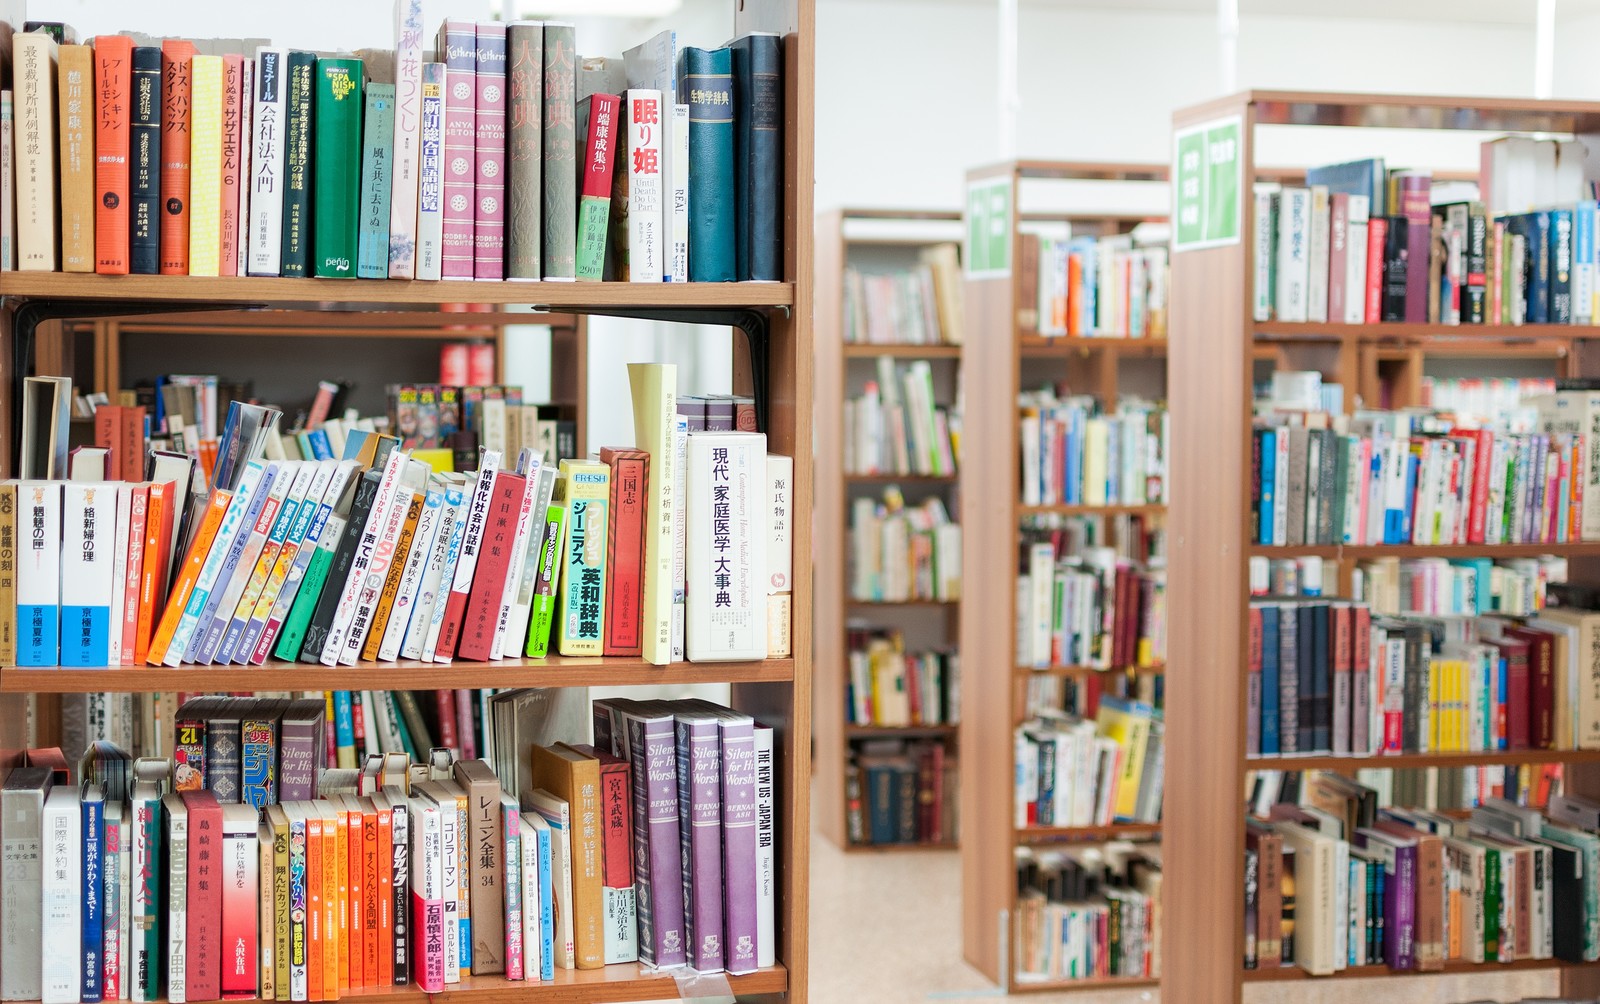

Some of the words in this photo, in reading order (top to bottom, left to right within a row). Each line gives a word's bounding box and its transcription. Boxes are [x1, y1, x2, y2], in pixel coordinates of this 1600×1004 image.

[101, 59, 110, 130] レールモントフ
[166, 62, 176, 132] スタインベック
[177, 62, 187, 132] ドス・パソス
[225, 65, 237, 105] よりぬき
[262, 53, 275, 101] ゼミナール
[333, 82, 356, 90] NISH
[691, 89, 730, 105] 生物学辞典
[24, 46, 40, 155] 最高裁判所判例解説
[68, 70, 84, 133] 徳川家康
[224, 110, 238, 169] サザエさん
[257, 105, 277, 193] 会社法入門
[633, 99, 659, 174] 眠り姫
[224, 175, 233, 185] 6
[370, 147, 385, 227] 風と共に去りぬ
[636, 179, 655, 187] Until
[638, 203, 653, 211] Part
[675, 189, 685, 215] REAL
[677, 436, 686, 458] RSPB
[712, 447, 730, 481] 現代
[369, 455, 400, 533] 人生がうまくいかない人は
[574, 473, 607, 483] FRESH
[738, 472, 748, 516] Contemporary
[463, 468, 495, 557] 情報化社会対話集
[490, 489, 513, 557] 夏目漱石集
[661, 485, 672, 535] 分析資料
[713, 485, 731, 551] 家庭医学
[774, 480, 786, 531] 源氏物語
[1, 525, 13, 570] 修羅の刻
[32, 506, 45, 550] 魍魎の匣
[82, 507, 95, 562] 絡新婦の理
[349, 516, 362, 538] 天使
[431, 507, 458, 572] 今夜は眠れない
[571, 501, 587, 566] ジーニアス
[587, 506, 601, 562] フレッシュ
[675, 509, 684, 583] BIRDWATCHING
[739, 519, 748, 537] Home
[127, 521, 144, 580] ピーチガール
[354, 532, 376, 570] 声で損
[384, 529, 412, 591] あした天気になあれ
[739, 540, 748, 565] Medical
[578, 567, 601, 636] 英和辞典
[622, 582, 630, 621] 吉川英治全集
[714, 556, 732, 608] 大事典
[739, 567, 749, 608] Encyclopedia
[32, 607, 44, 647] 京極夏彦
[81, 607, 93, 647] 京極夏彦
[347, 605, 370, 650] 猿渡哲也
[497, 604, 511, 633] 深見東州
[180, 727, 198, 743] 12
[251, 732, 270, 743] 少年
[650, 759, 663, 769] for
[694, 760, 708, 771] for
[729, 762, 741, 774] for
[758, 749, 770, 765] THE
[758, 766, 770, 783] NEW
[581, 784, 596, 838] 徳川家康
[759, 784, 770, 798] US
[479, 796, 496, 870] レーニン全集
[508, 809, 520, 837] NON
[701, 809, 718, 817] ASH
[759, 803, 771, 831] JAPAN
[5, 844, 38, 852] 新日本
[5, 853, 38, 861] 文学全集
[54, 816, 68, 881] 国際条約集
[107, 824, 119, 854] NON
[137, 806, 153, 906] 新しい日本人へ
[198, 820, 211, 891] 島崎藤村集
[444, 823, 456, 888] ゴリラーマン
[541, 835, 550, 872] 冒険と日本人
[760, 832, 772, 848] ERA
[5, 865, 27, 881] 23
[235, 842, 246, 889] 秋に墓標を
[309, 836, 319, 891] 紅色HERO
[324, 837, 335, 900] 問題のない私たち
[392, 845, 408, 887] レガッタ
[481, 875, 495, 887] 34
[275, 866, 288, 924] 翔んだカップル
[365, 851, 377, 930] すくらんぶる同盟
[172, 940, 184, 954] 7
[426, 904, 443, 954] 石原慎太郎
[447, 927, 455, 969] ハロルド作石
[508, 910, 522, 954] 菊地秀行
[104, 929, 117, 976] 菊地秀行
[138, 950, 149, 990] 落合信彦
[171, 955, 184, 977] 田中
[198, 926, 207, 978] 日本文學全集
[235, 937, 246, 975] 大沢在昌
[427, 956, 435, 977] 研究所
[171, 979, 184, 991] 宏
